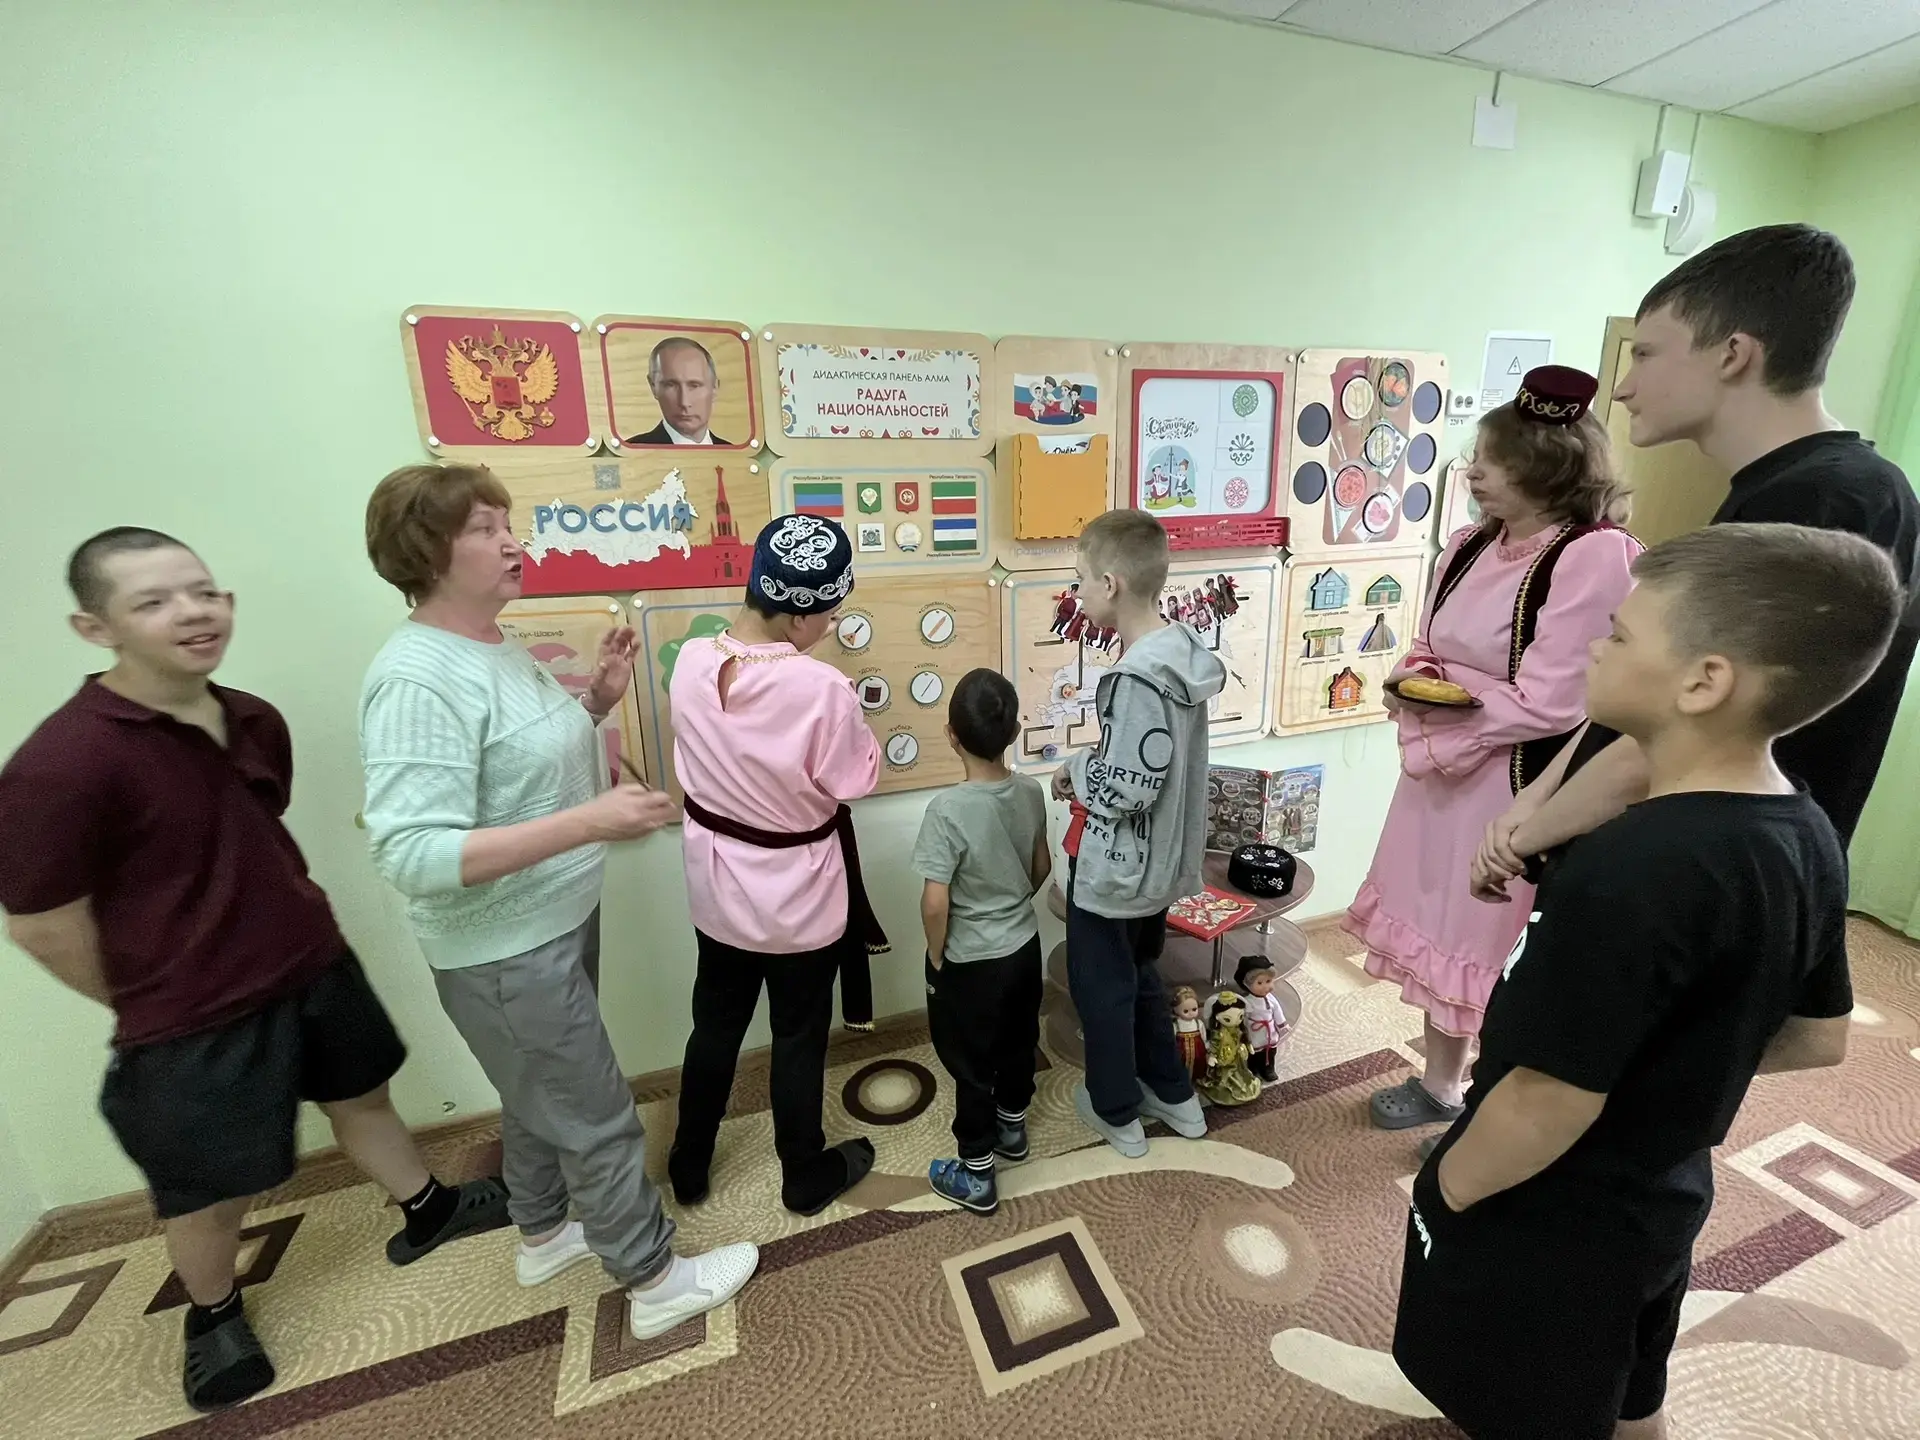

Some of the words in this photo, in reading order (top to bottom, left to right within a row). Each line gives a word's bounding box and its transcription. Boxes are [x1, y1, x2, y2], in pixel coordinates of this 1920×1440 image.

[812, 369, 888, 381] ДИДАКТИЧЕСКАЯ
[889, 373, 923, 383] ПАНЕЛЬ
[925, 374, 950, 383] АЛМА
[857, 388, 907, 402] РАДУГА
[817, 403, 949, 418] НАЦИОНАЛЬНОСТЕЙ
[534, 503, 693, 534] РОССИЯ
[1162, 584, 1186, 593] ссии
